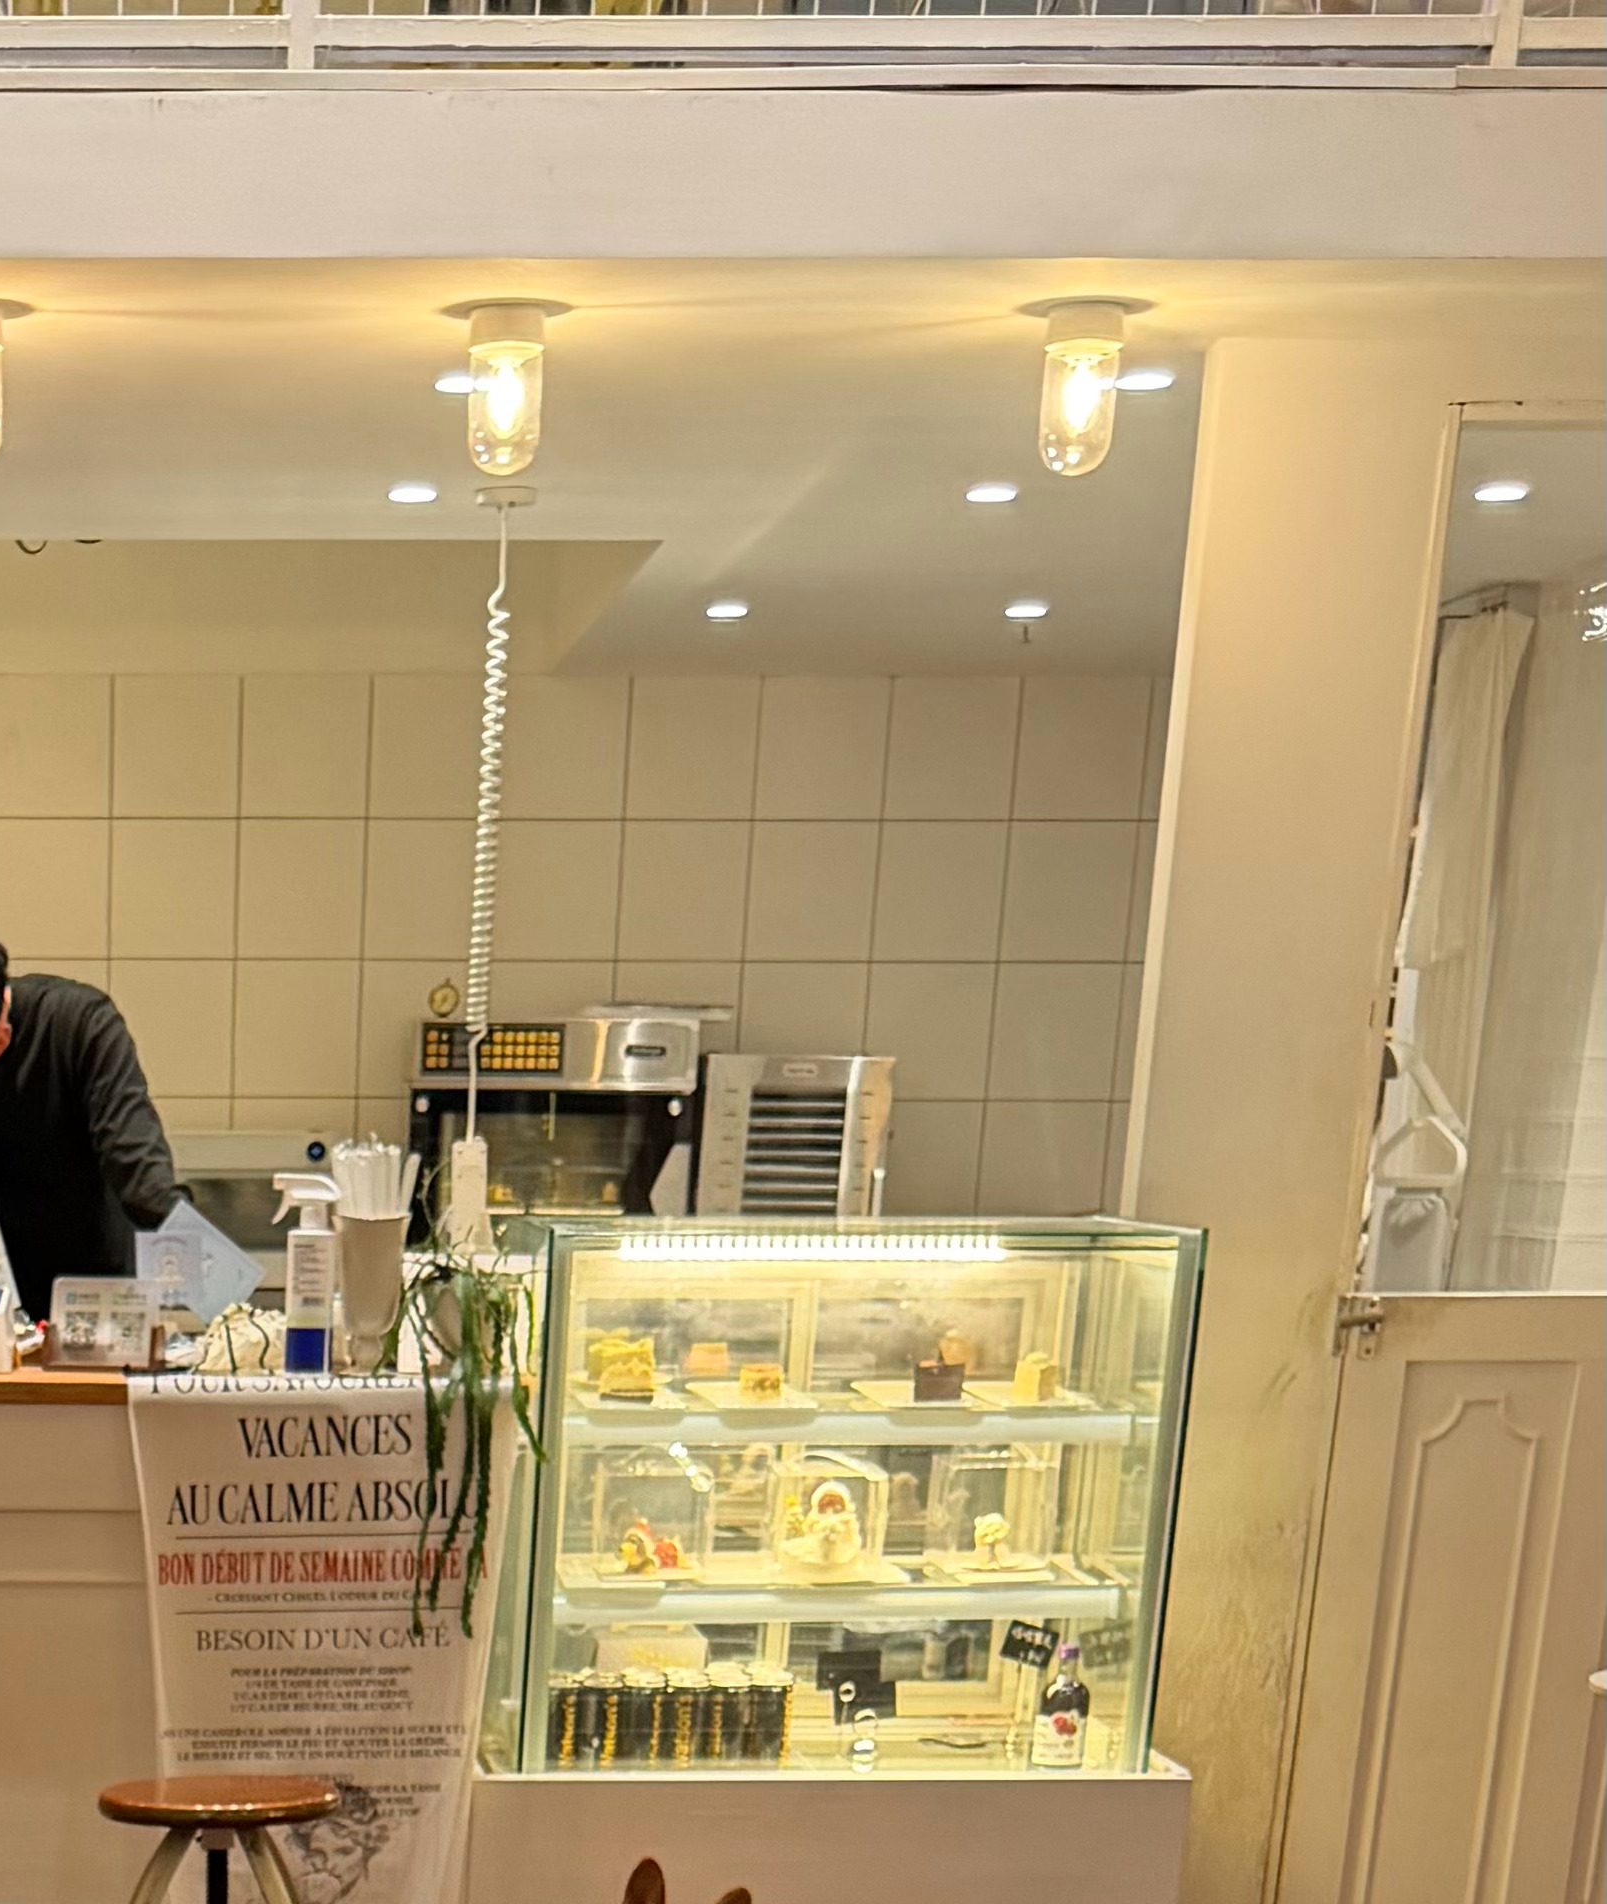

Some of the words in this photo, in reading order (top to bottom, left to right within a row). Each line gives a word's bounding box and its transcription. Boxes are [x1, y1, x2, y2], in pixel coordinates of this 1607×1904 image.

[238, 1414, 412, 1458] VACANCES
[168, 1484, 210, 1525] AU
[218, 1481, 338, 1524] CALME
[158, 1553, 195, 1586] BON
[202, 1548, 265, 1585] DÉBUT
[271, 1552, 293, 1583] DE
[299, 1550, 387, 1583] SEMAINE
[196, 1629, 295, 1651] BESOIN
[305, 1628, 371, 1650] D'UN
[379, 1620, 451, 1649] CAFÉ
